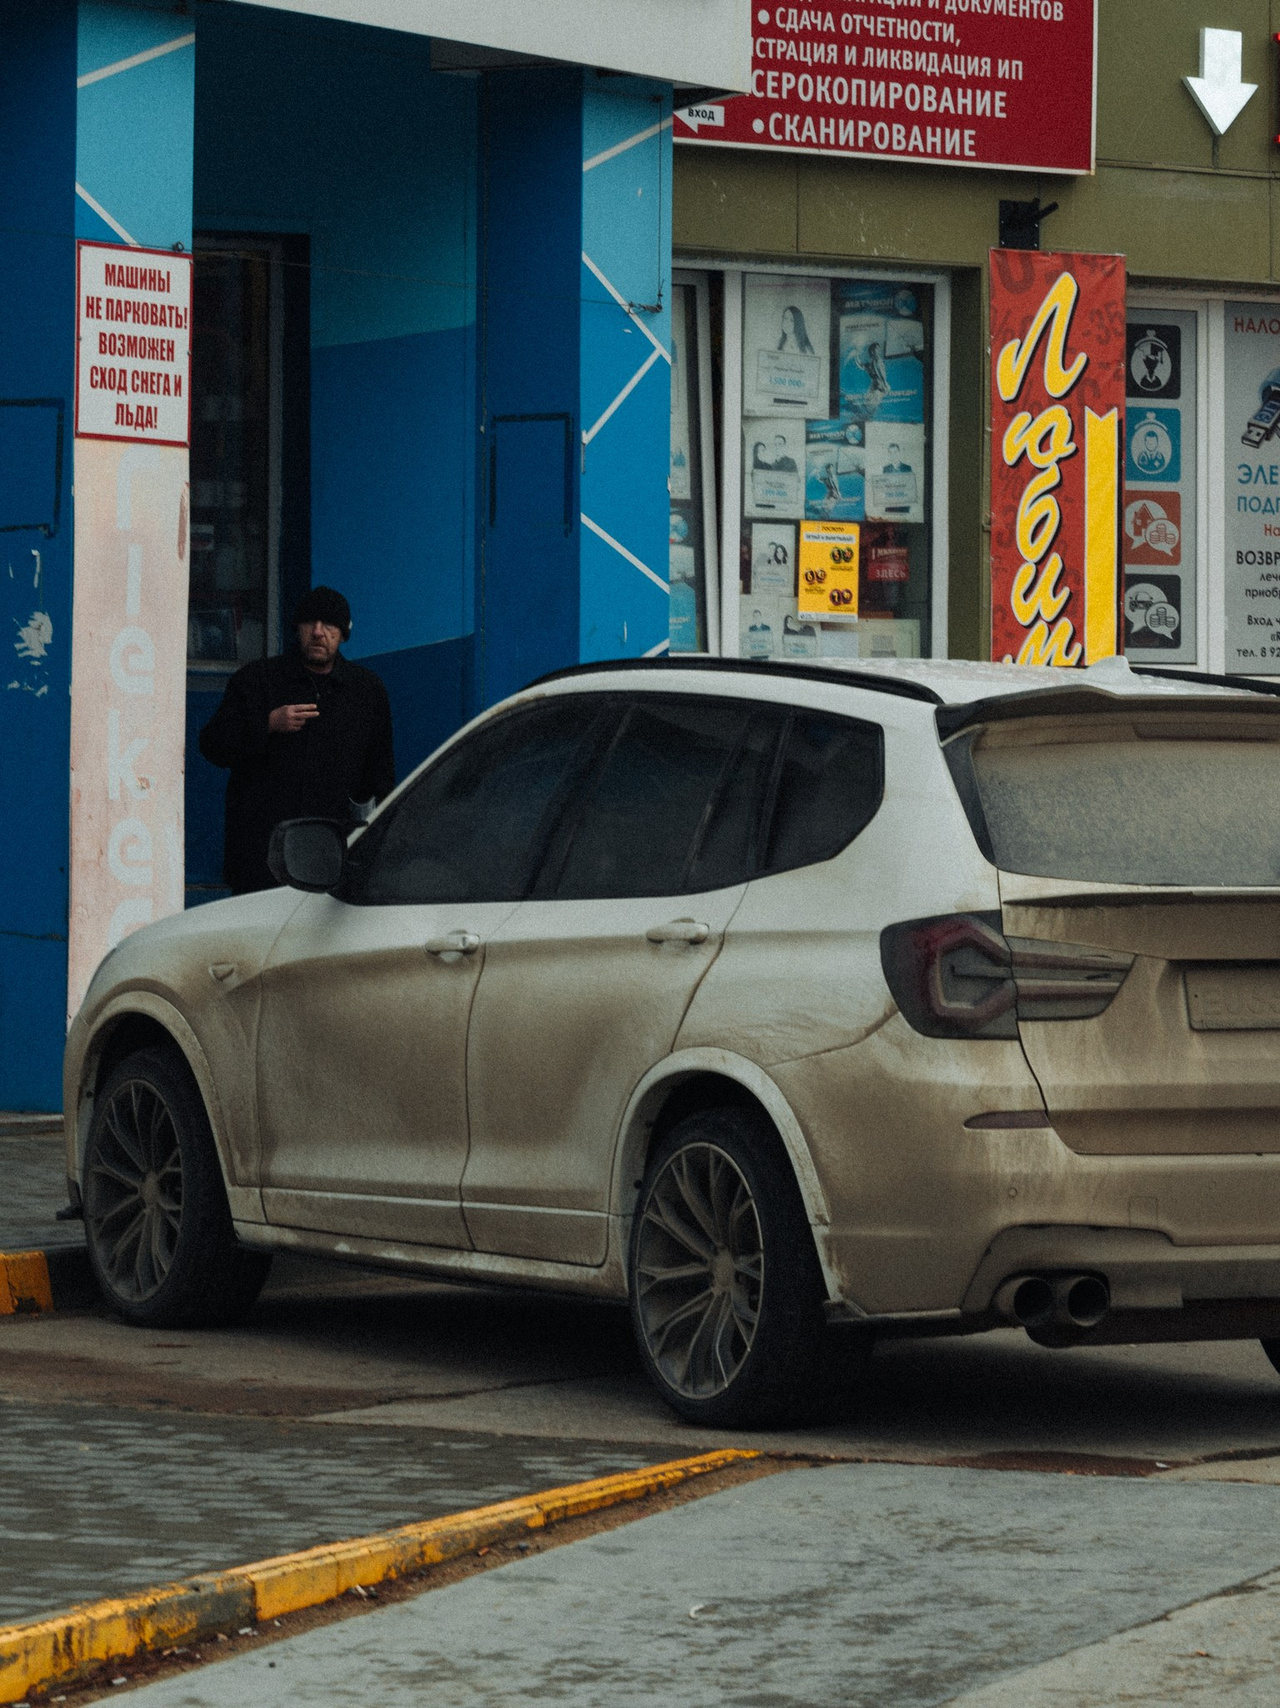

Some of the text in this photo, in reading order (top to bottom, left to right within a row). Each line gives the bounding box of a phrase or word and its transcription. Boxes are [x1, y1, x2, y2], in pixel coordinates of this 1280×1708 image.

[775, 7, 961, 47] СДАЧА ОТЧЕТНОСТИ,
[844, 45, 857, 66] И
[861, 46, 991, 79] ЛИКВИДАЦИЯ
[997, 61, 1023, 80] ИП
[747, 69, 1007, 118] СЕРОКОПИРОВАНИЕ
[688, 107, 715, 121] ВХОД
[768, 112, 977, 157] СКАНИРОВАНИЕ
[104, 263, 171, 294] МАШИНЫ
[86, 296, 188, 330] НЕ ПАРКОВАТЬ!
[98, 332, 175, 363] ВОЗМОЖЕН
[90, 366, 182, 398] СХОД СНЕГА И
[114, 402, 158, 431] ЛЬДА!
[1247, 615, 1274, 627] Вход
[1237, 647, 1258, 658] тел.
[1260, 647, 1267, 658] 8
